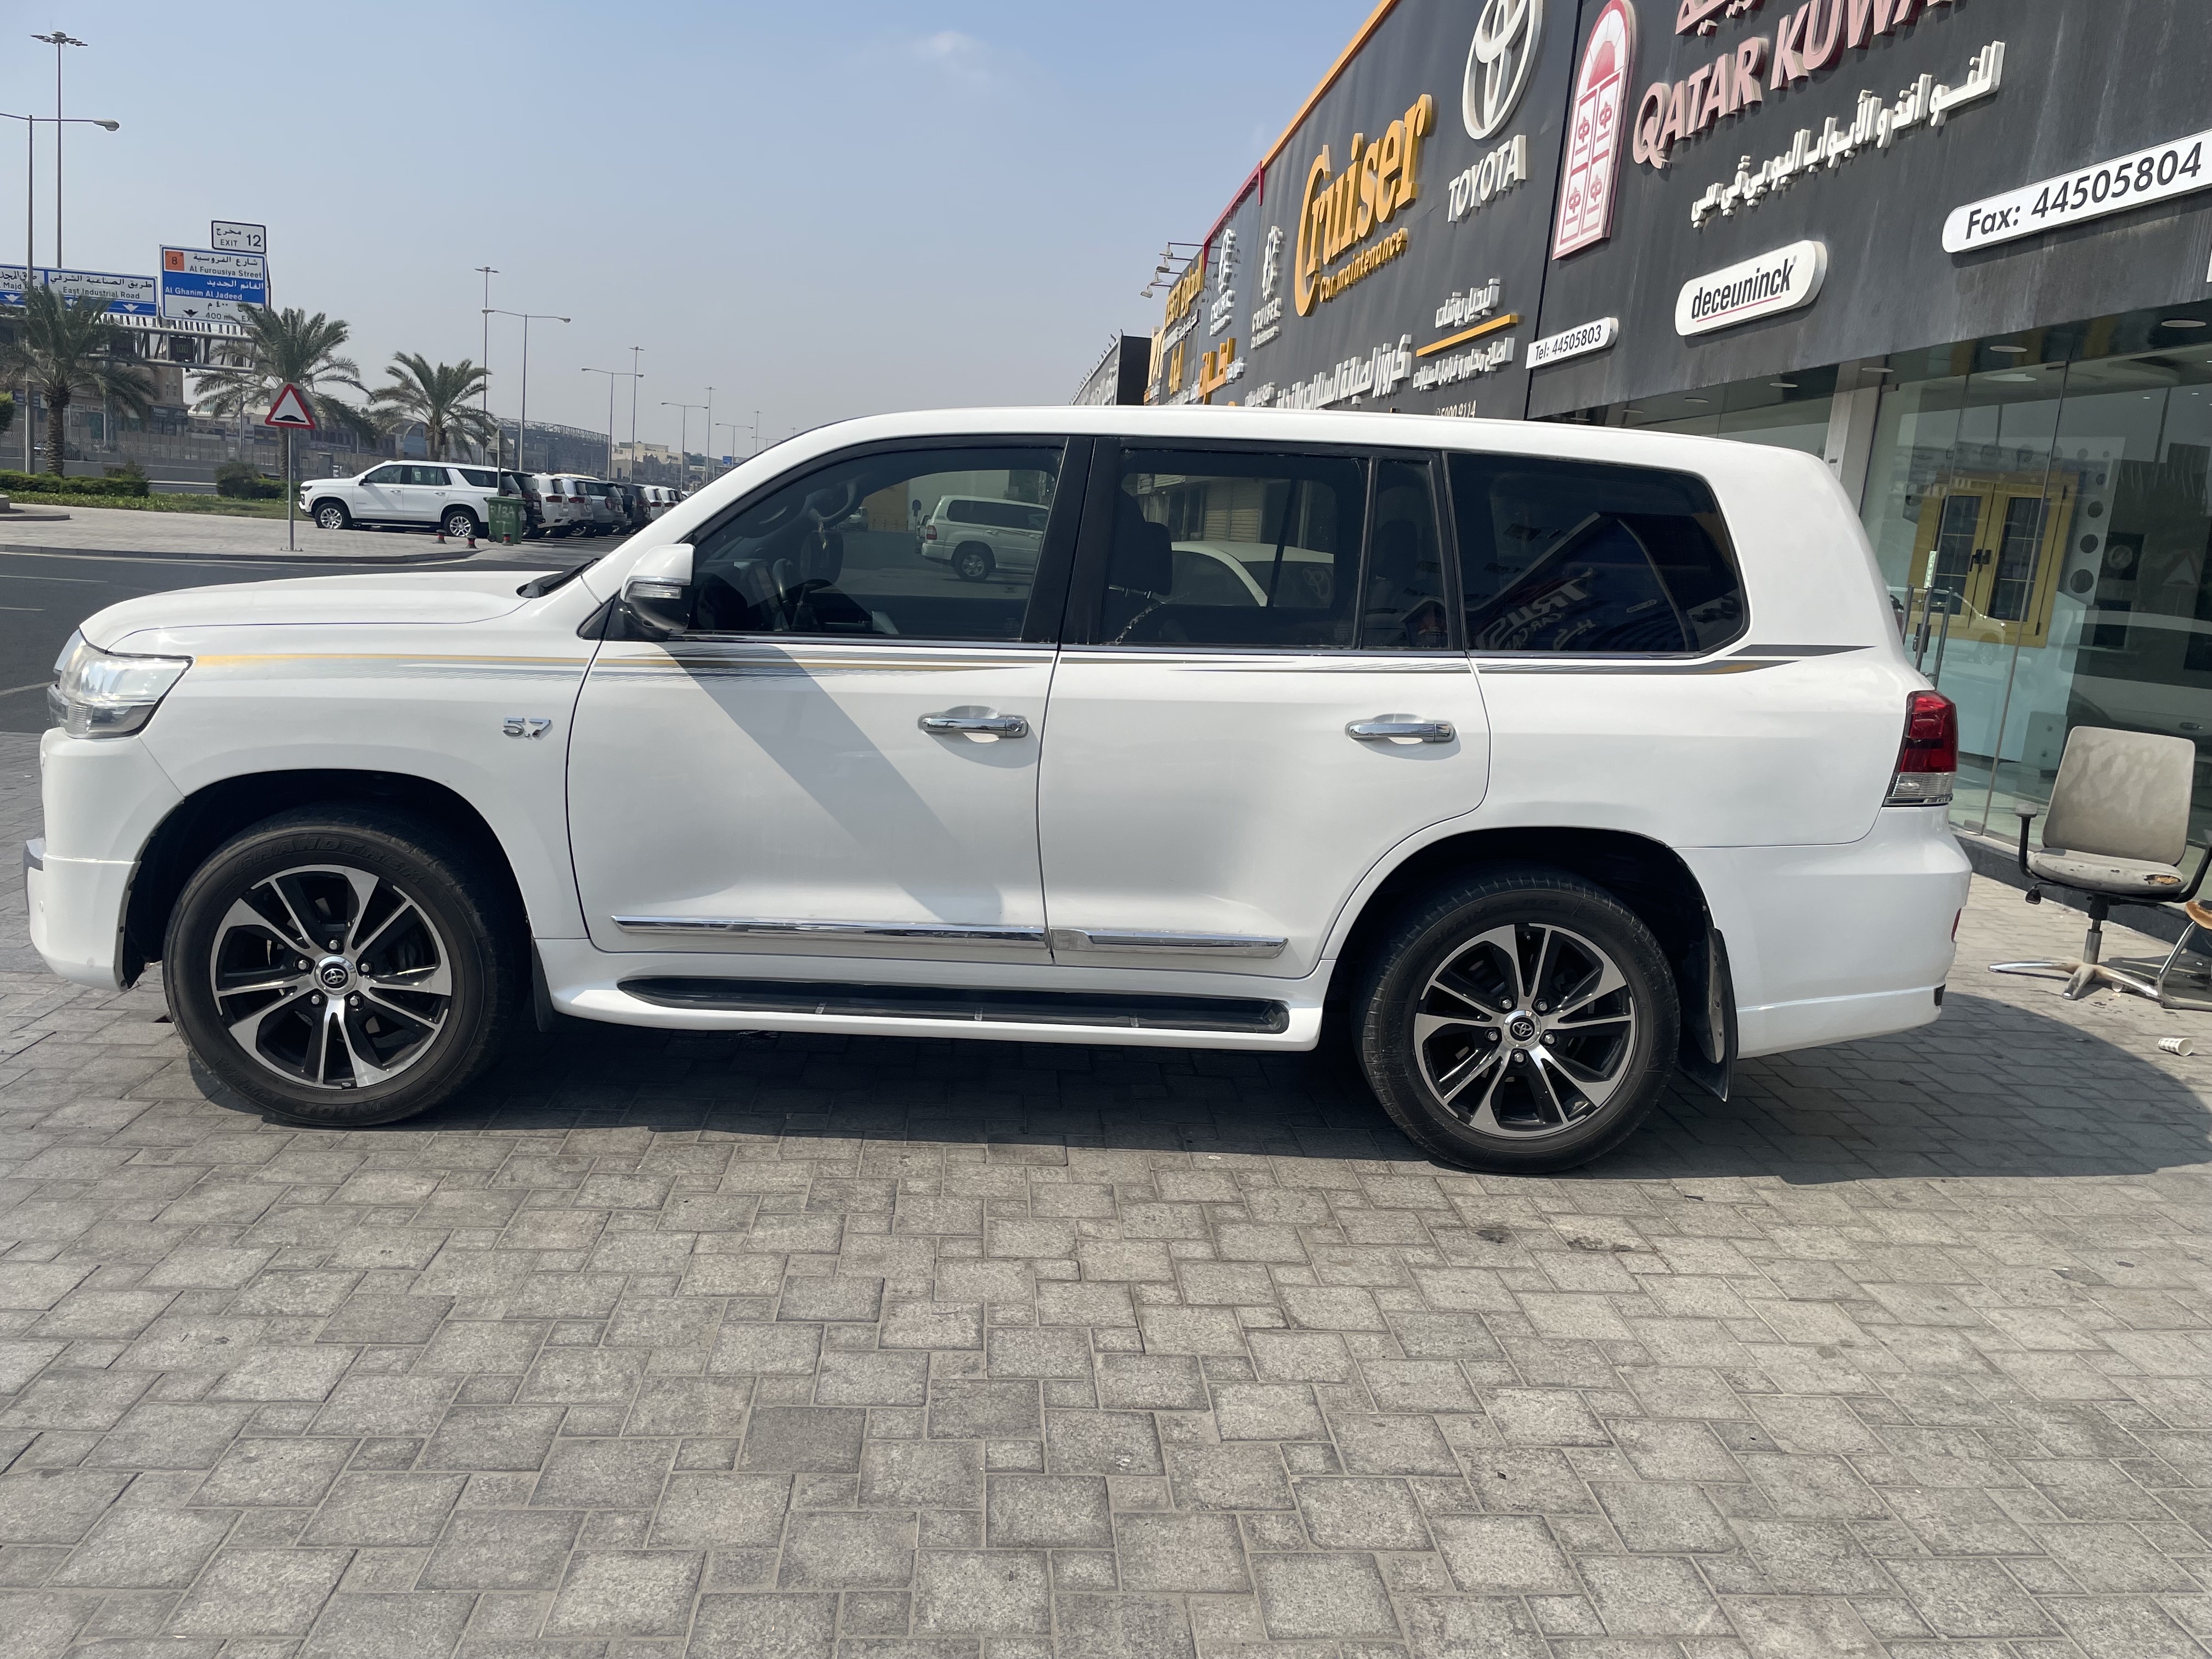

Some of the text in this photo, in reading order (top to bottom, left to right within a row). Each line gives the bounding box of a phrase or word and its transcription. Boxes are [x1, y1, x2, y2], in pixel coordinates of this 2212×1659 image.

[1633, 37, 1767, 168] QATAR
[1448, 134, 1526, 222] TOYOTA
[1966, 142, 2202, 240] Fax: 44505804
[1294, 93, 1433, 317] Cruiser
[246, 234, 262, 247] 12
[172, 256, 178, 265] 8
[193, 253, 232, 264] الفروسية
[236, 258, 258, 267] شارع
[1319, 228, 1408, 303] Car maintenance
[200, 267, 235, 276] Furousiya
[239, 270, 262, 279] Street
[3, 281, 22, 290] Majd
[128, 279, 153, 289] طريق
[1691, 258, 1795, 319] deceuninck
[63, 287, 140, 300] East Industrial Road
[175, 287, 204, 296] Ghanim
[216, 292, 242, 301] Jadeed
[1536, 325, 1601, 360] Tel: 44505803
[503, 717, 551, 738] 5.7
